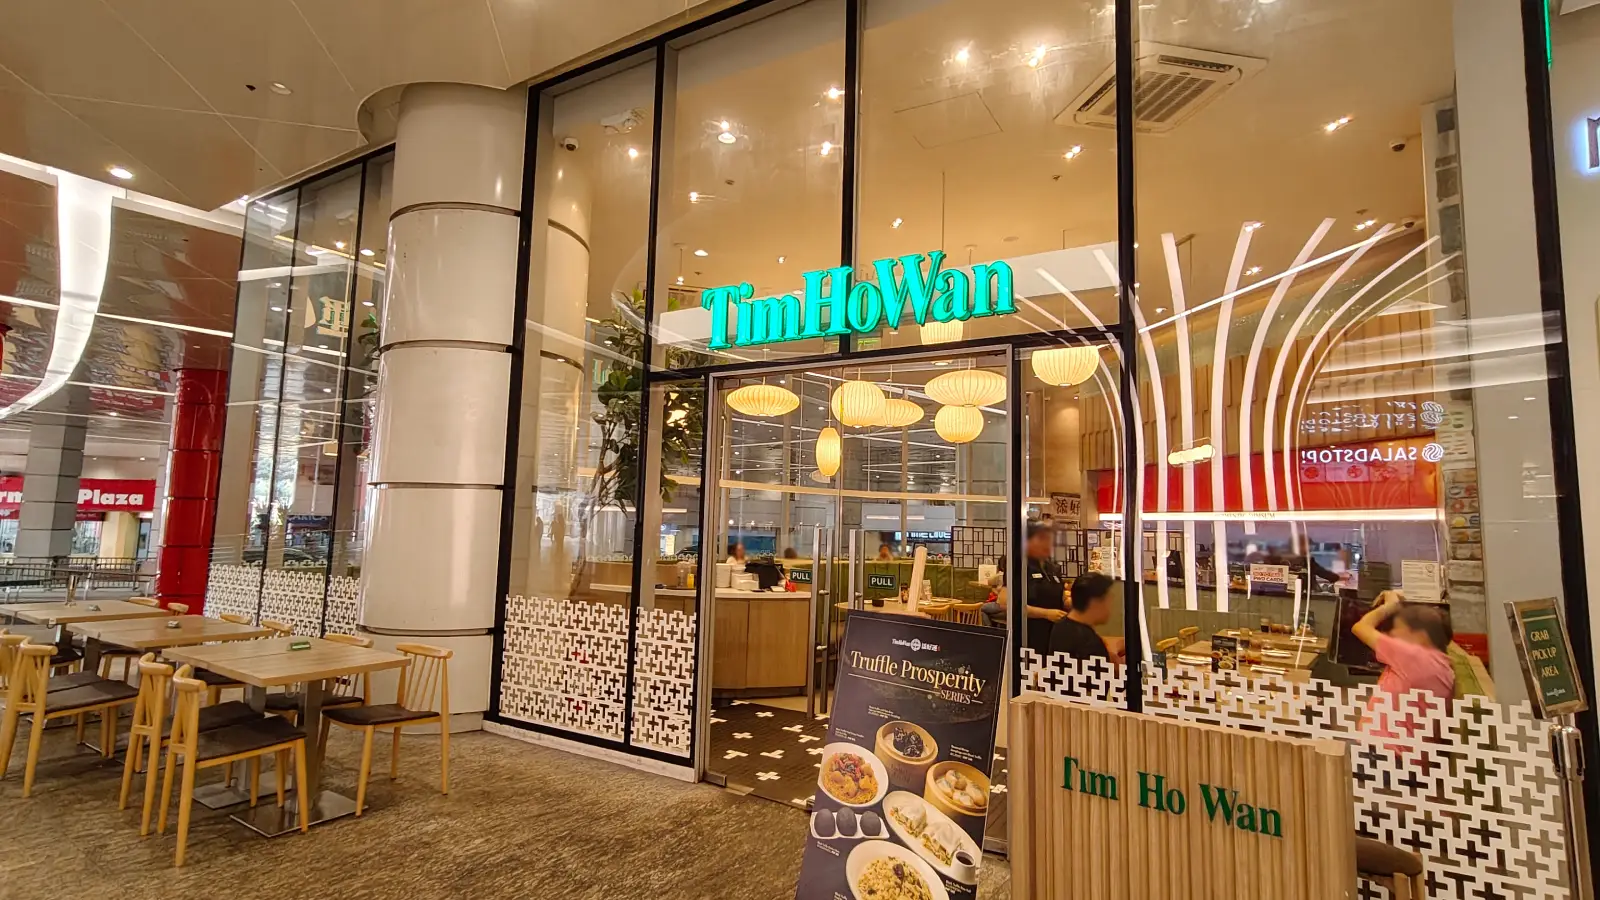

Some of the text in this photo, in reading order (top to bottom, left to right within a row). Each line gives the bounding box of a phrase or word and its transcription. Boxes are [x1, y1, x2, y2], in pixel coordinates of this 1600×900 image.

[77, 489, 144, 505] Plaza
[792, 571, 811, 581] PULL
[871, 577, 893, 586] PULL
[1530, 630, 1550, 641] GRAB
[1532, 646, 1557, 660] PICK UP
[851, 650, 986, 697] Truffle Prosperity
[1541, 665, 1559, 677] AREA
[940, 689, 971, 705] SERIES
[1061, 756, 1283, 838] Tim Ho Wan
